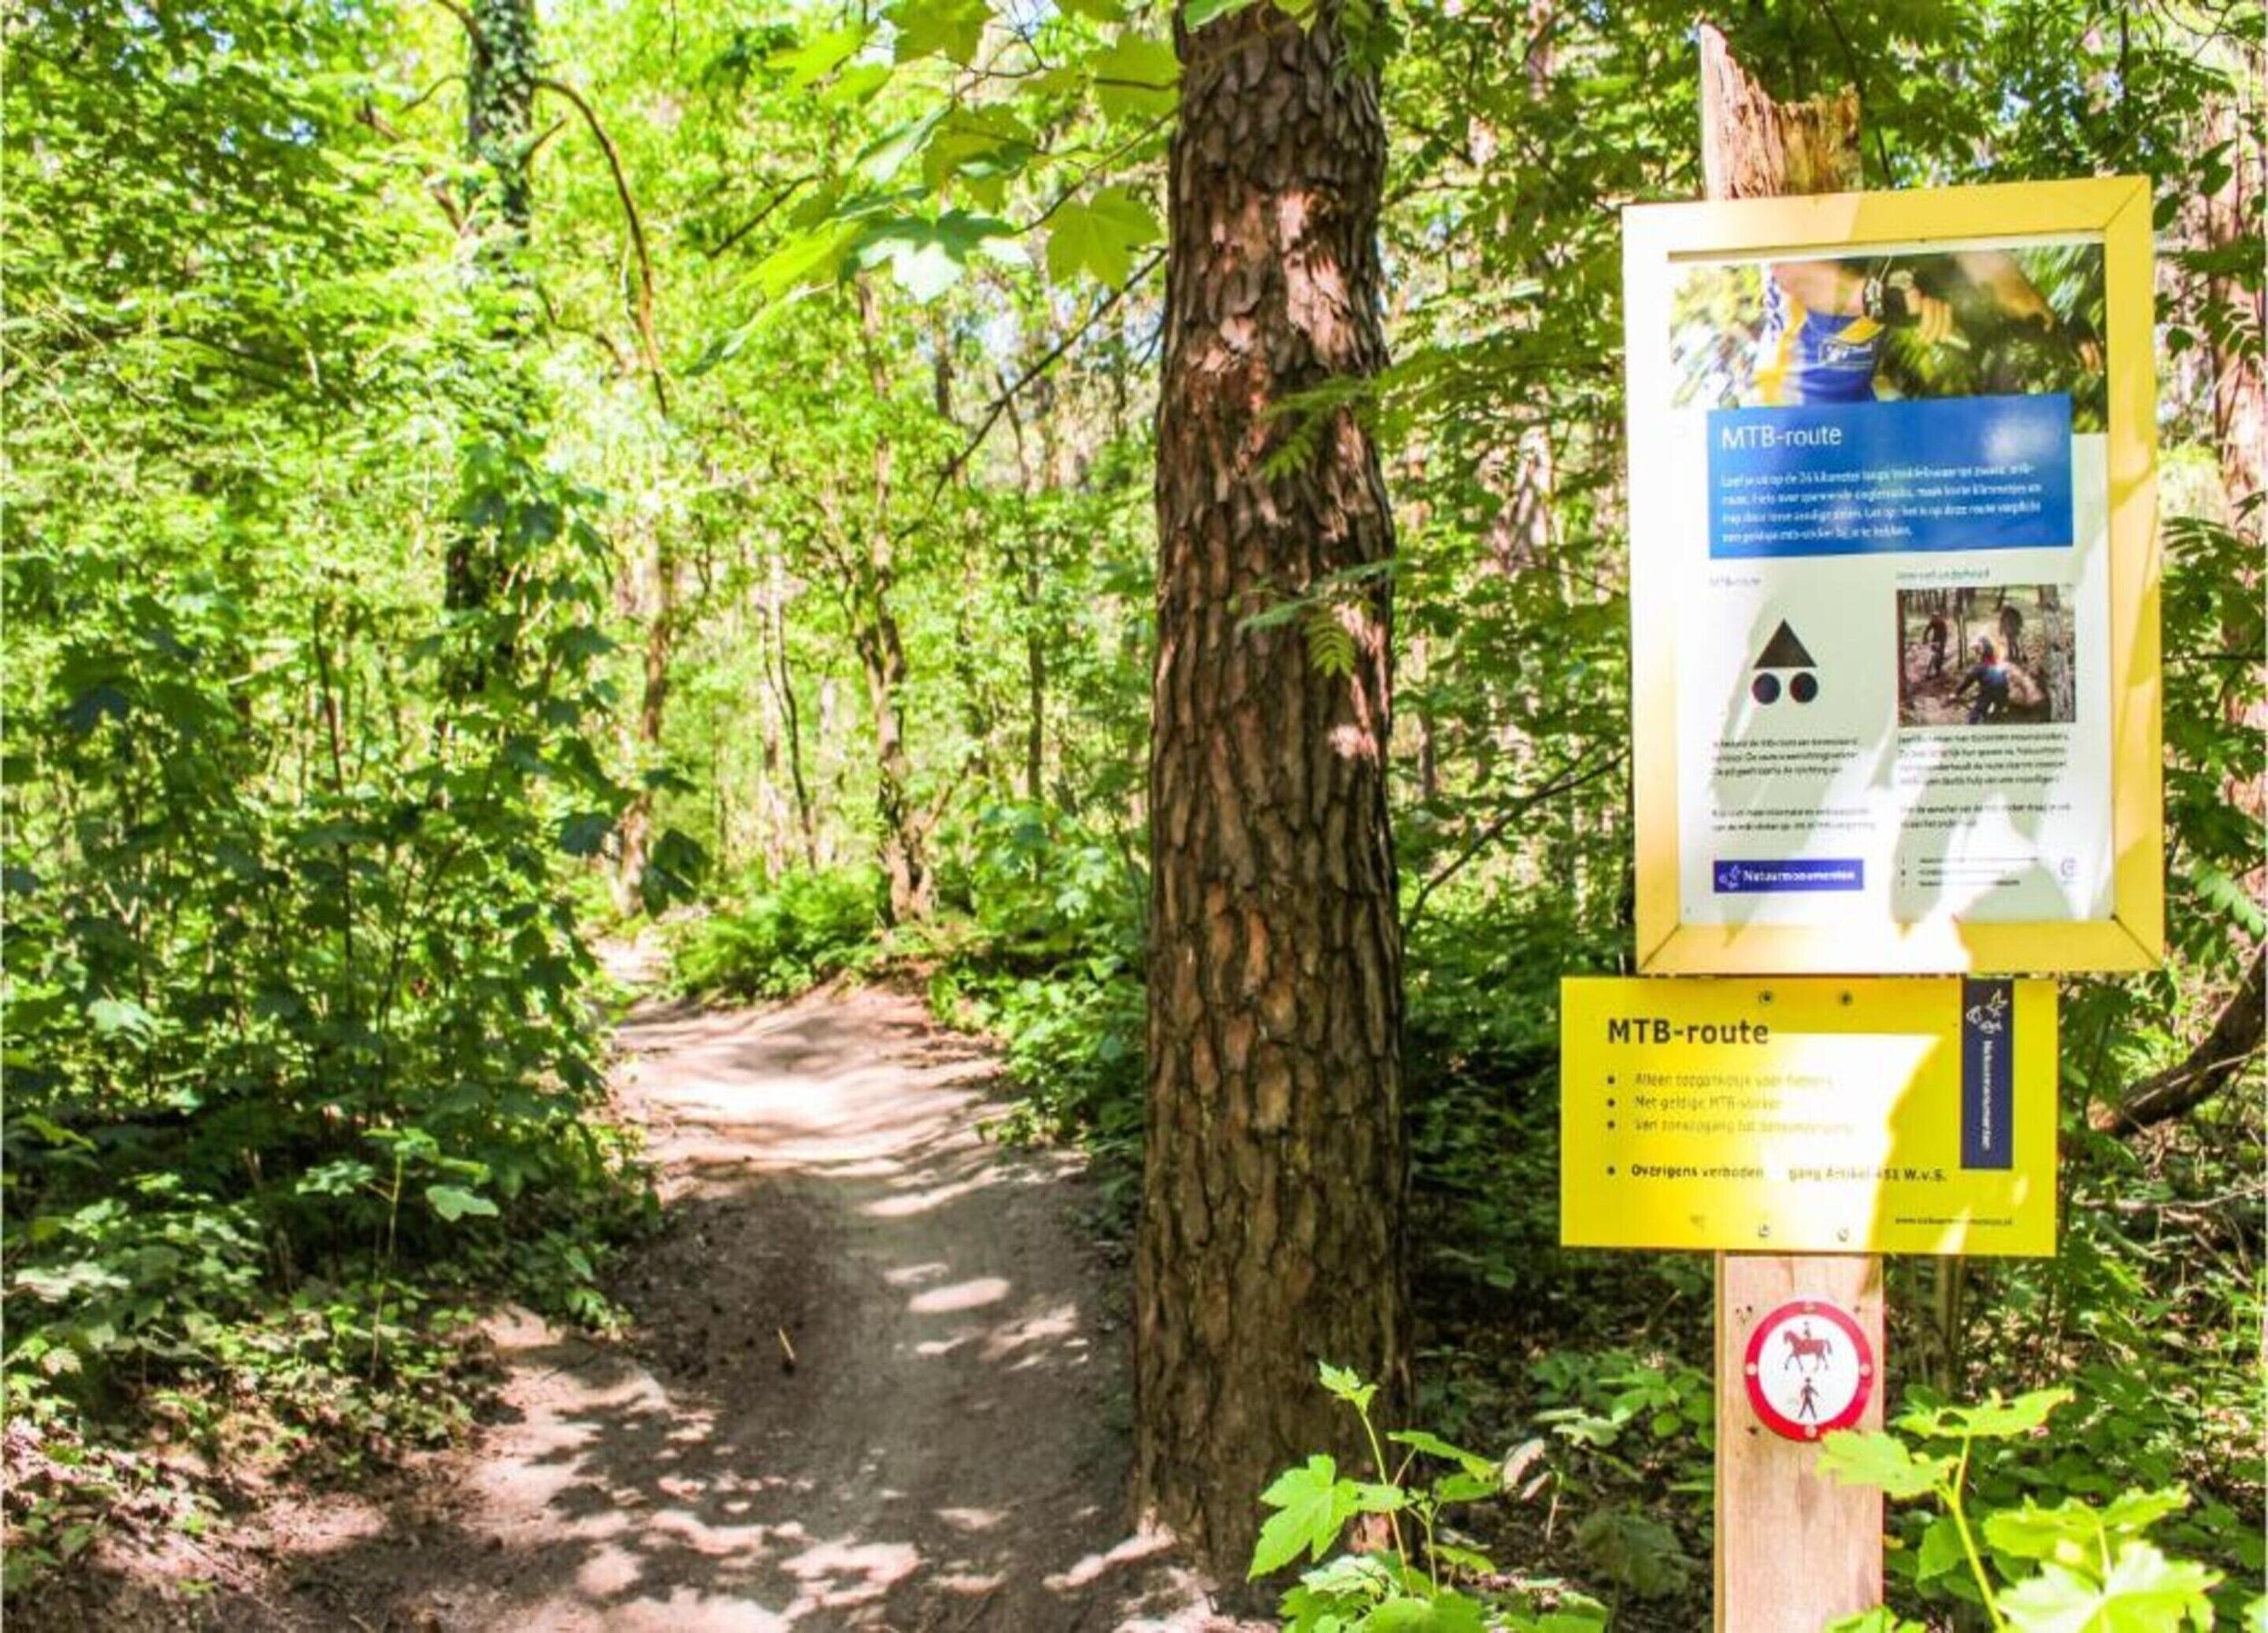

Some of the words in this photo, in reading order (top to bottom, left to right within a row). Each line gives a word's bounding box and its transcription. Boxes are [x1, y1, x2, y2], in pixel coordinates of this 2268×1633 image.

[1721, 425, 1842, 450] MTB-route
[1743, 869, 1855, 883] Natuurmonumenten
[1607, 1018, 1770, 1045] MTB-route
[1636, 1072, 1673, 1087] Alleen
[1636, 1095, 1658, 1107] Met
[1660, 1096, 1704, 1111] geldige
[1631, 1164, 1698, 1179] Overigens
[1703, 1165, 1764, 1178] verboden
[1788, 1168, 1822, 1183] gang
[1903, 1168, 1948, 1182] W.v.S.
